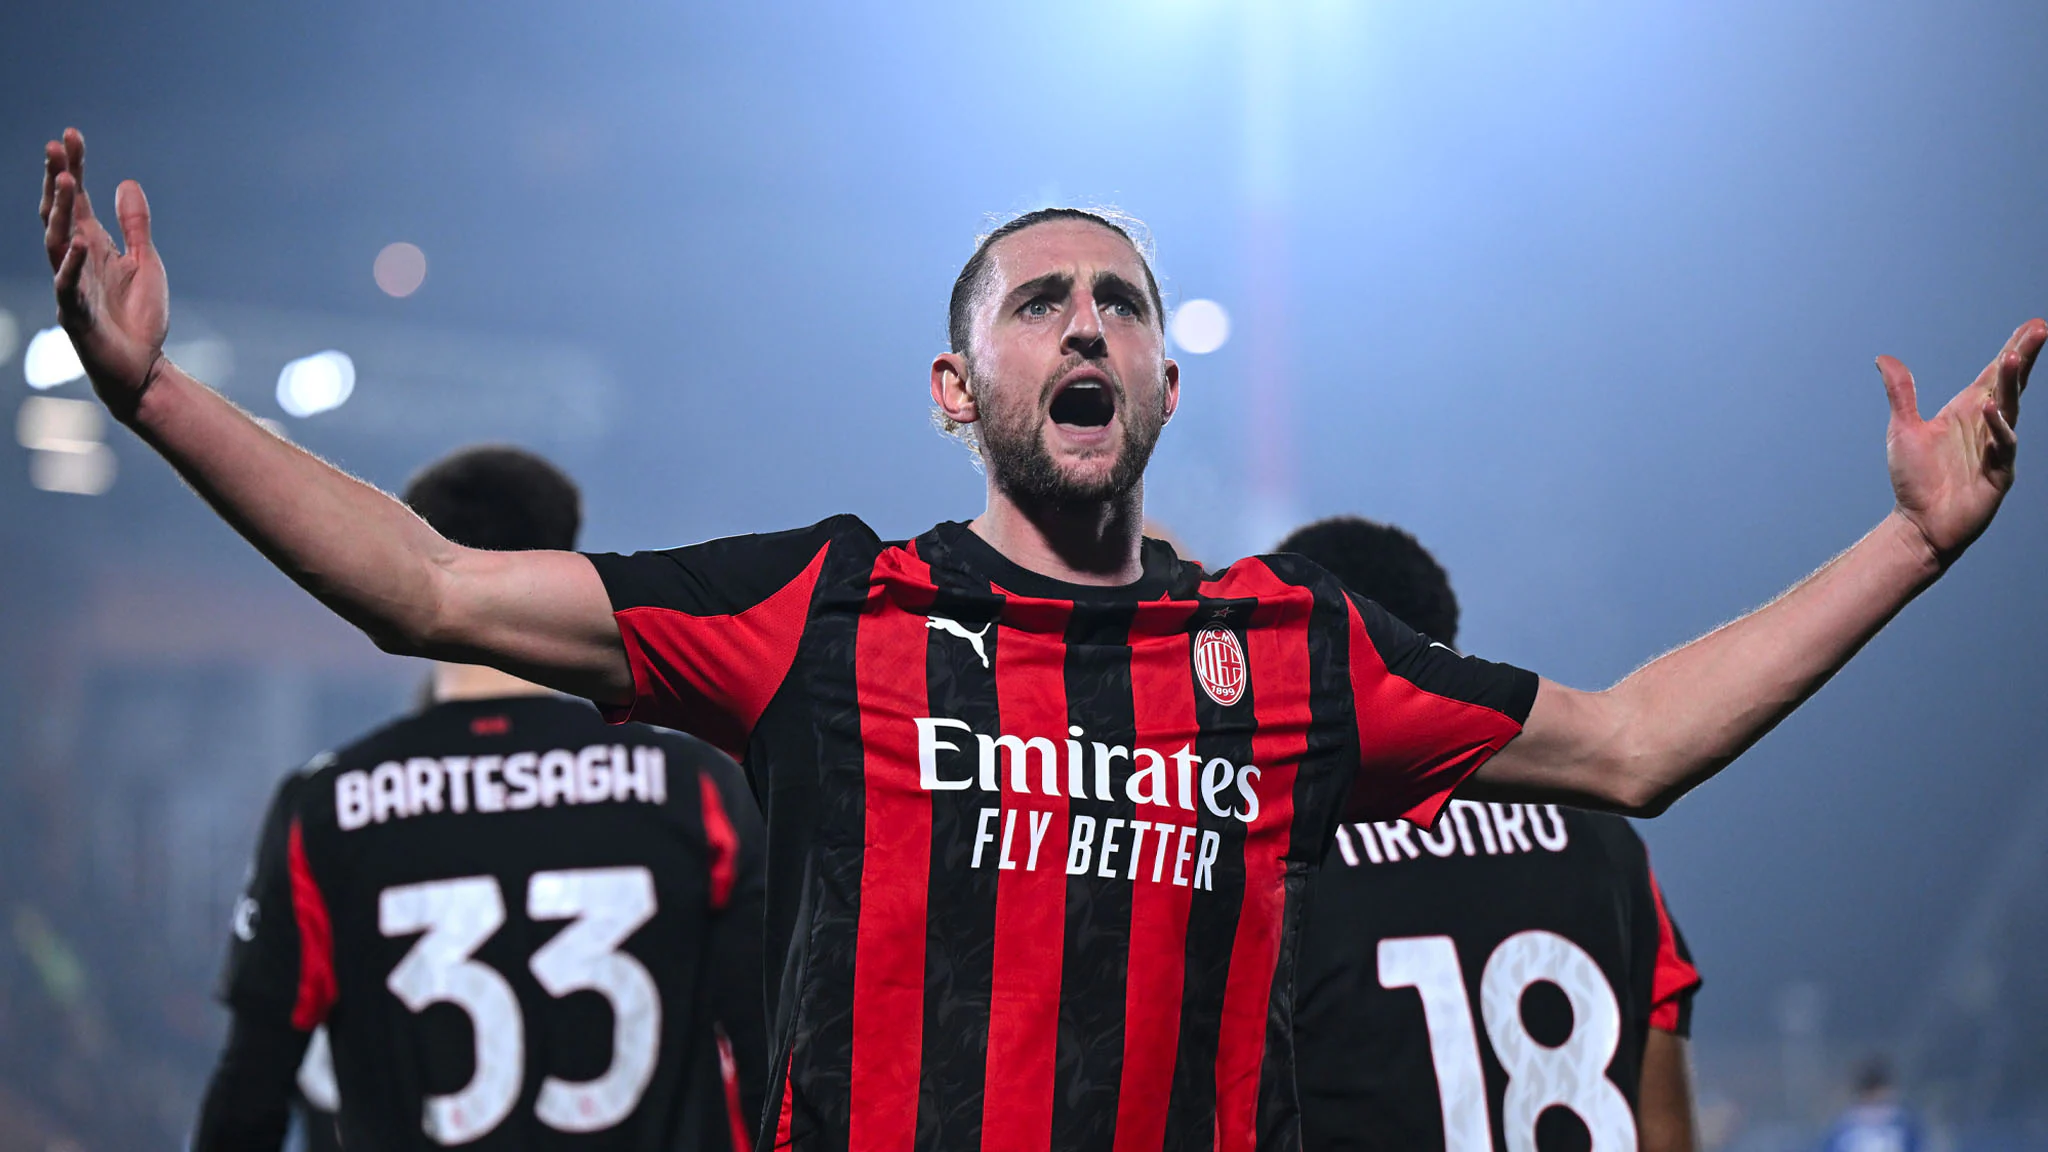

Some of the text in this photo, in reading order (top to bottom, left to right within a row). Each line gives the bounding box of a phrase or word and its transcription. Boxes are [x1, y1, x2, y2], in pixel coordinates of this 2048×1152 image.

[1203, 628, 1232, 645] ACM
[1211, 685, 1235, 697] 1899
[335, 743, 667, 832] BARTESAGHI
[913, 717, 1262, 823] Emirates
[970, 807, 1221, 892] FLY BETTER
[378, 865, 663, 1146] 33
[1376, 929, 1640, 1152] 18
